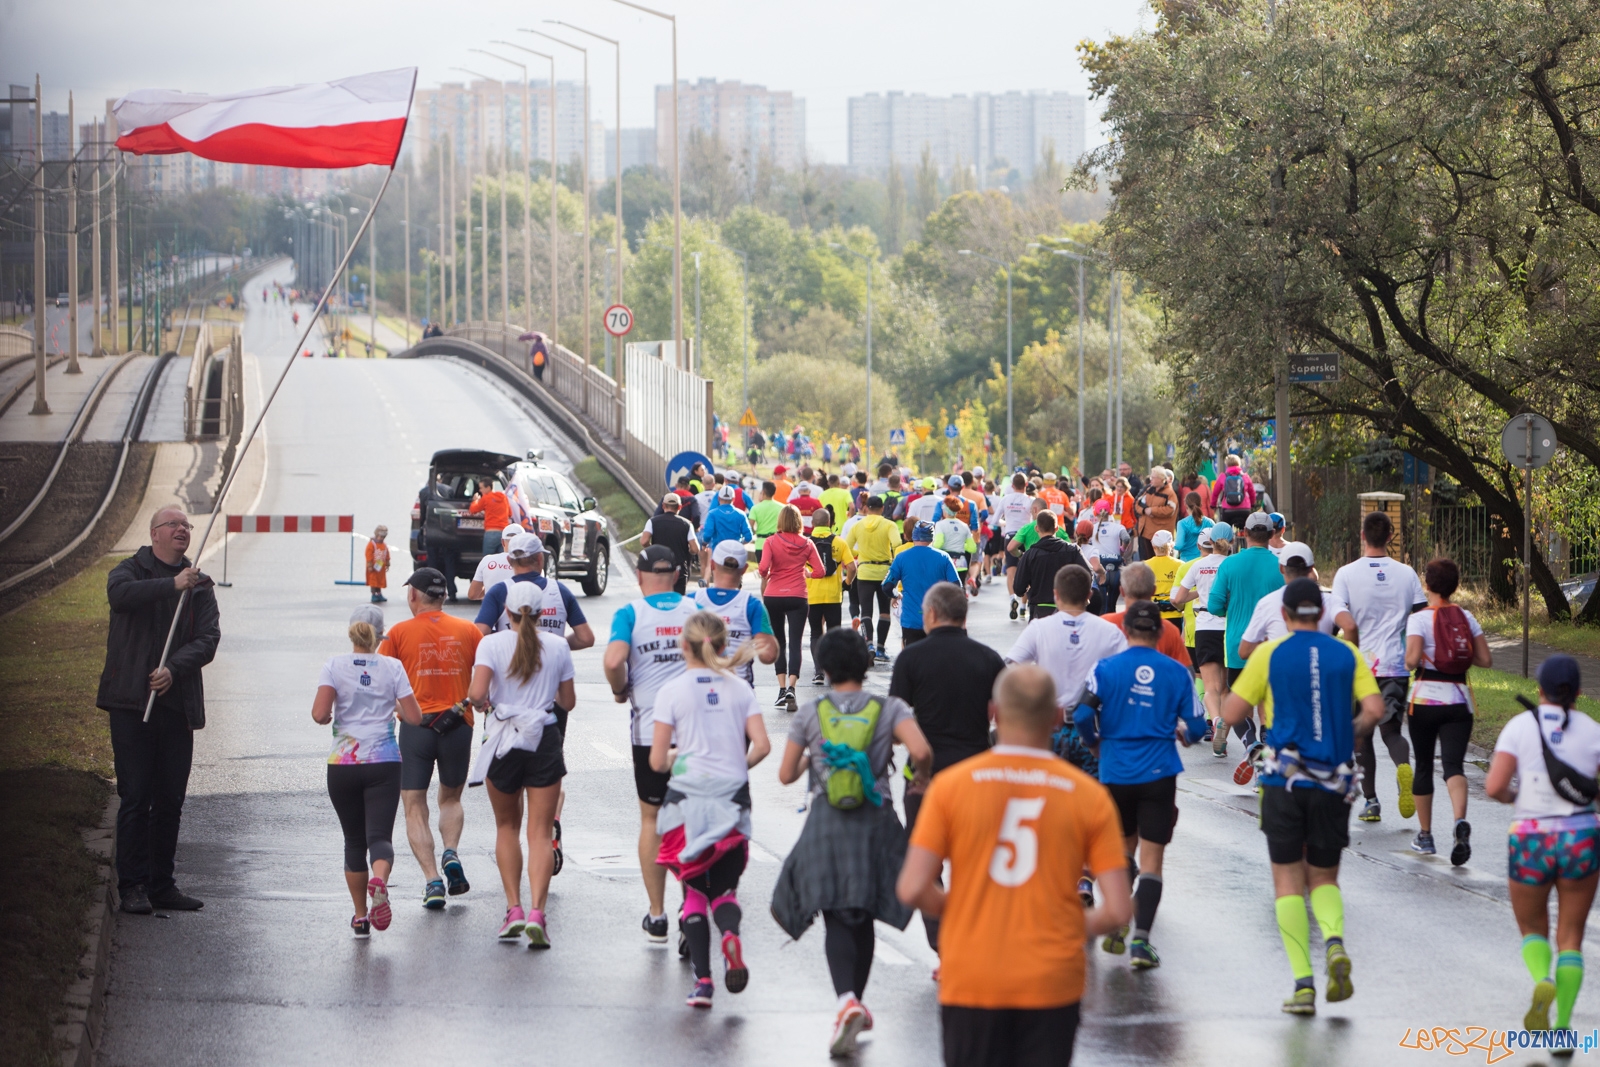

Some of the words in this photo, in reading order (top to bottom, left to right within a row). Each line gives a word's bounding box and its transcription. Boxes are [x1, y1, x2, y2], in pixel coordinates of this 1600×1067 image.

[610, 312, 628, 328] 70
[1291, 363, 1336, 374] Saperska
[989, 796, 1046, 887] 5
